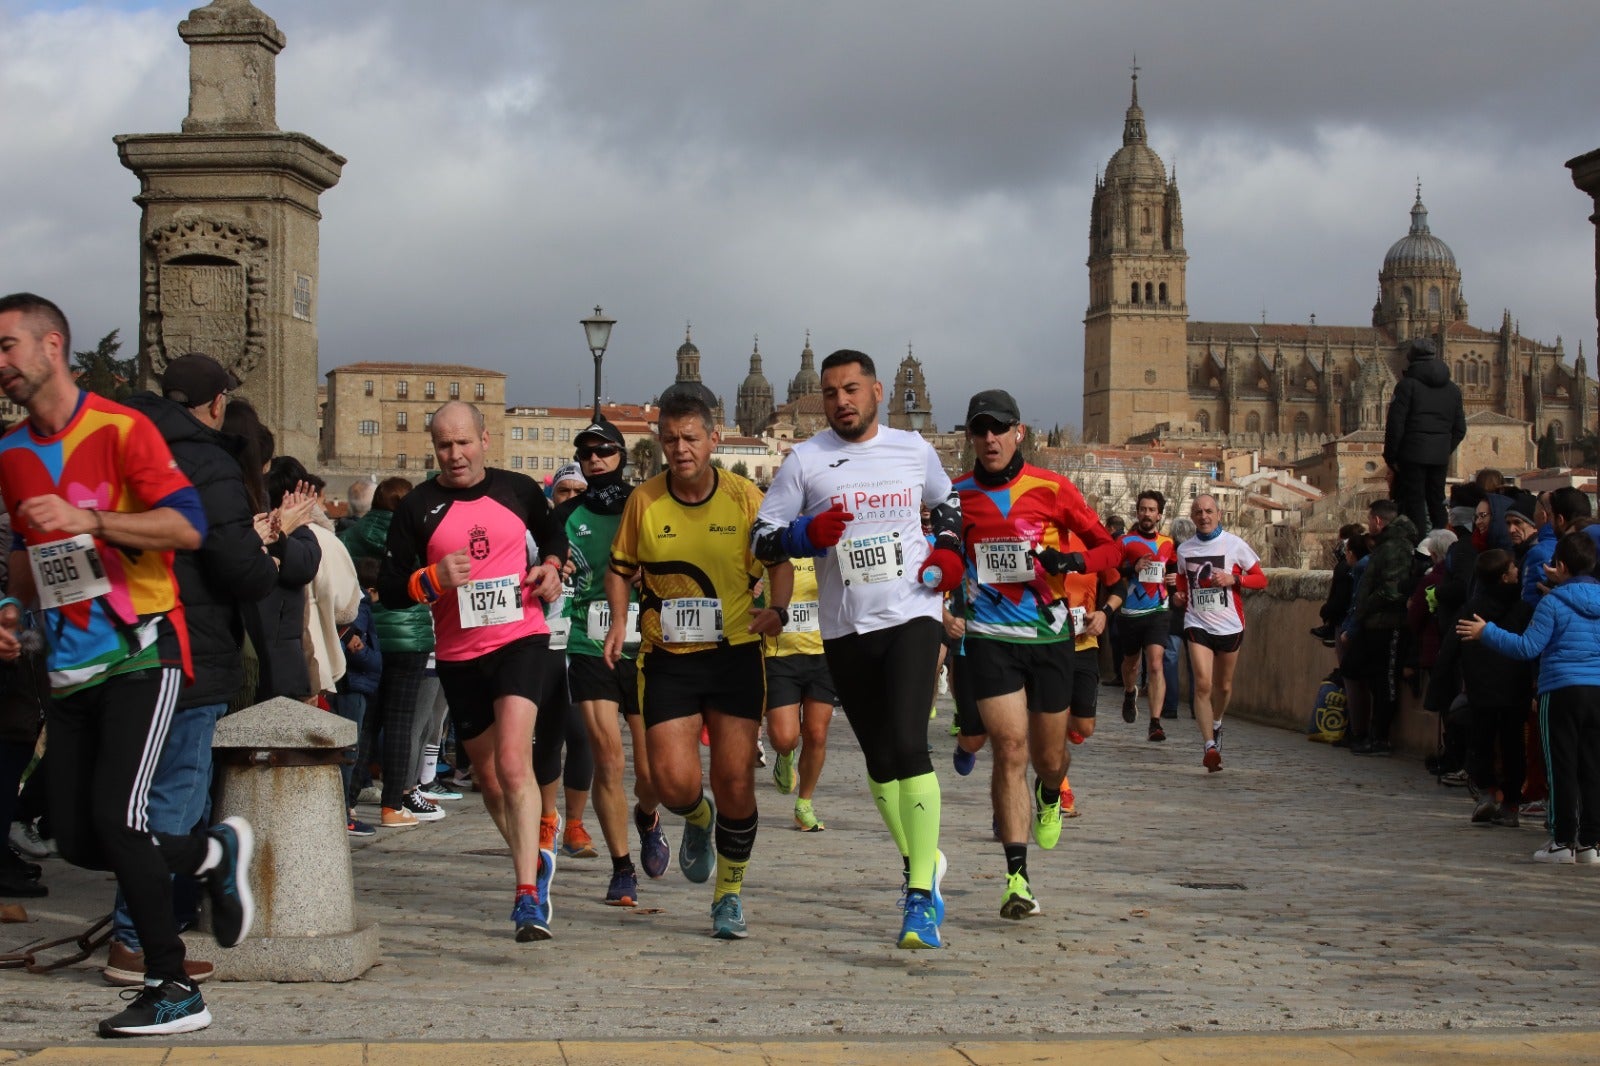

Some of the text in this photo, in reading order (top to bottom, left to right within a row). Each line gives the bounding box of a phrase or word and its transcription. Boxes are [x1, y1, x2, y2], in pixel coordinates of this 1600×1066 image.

[854, 488, 912, 510] Pernil
[857, 509, 912, 521] amanca
[41, 541, 85, 558] SETEL
[853, 535, 895, 549] SETEL
[989, 544, 1026, 552] SETEL
[849, 545, 887, 570] 1909
[986, 553, 1017, 570] 1643
[38, 555, 80, 587] 1896
[475, 578, 515, 590] SETEL
[470, 589, 507, 611] 1374
[676, 600, 715, 608] SETEL
[675, 609, 700, 627] 1171
[792, 609, 810, 622] 501
